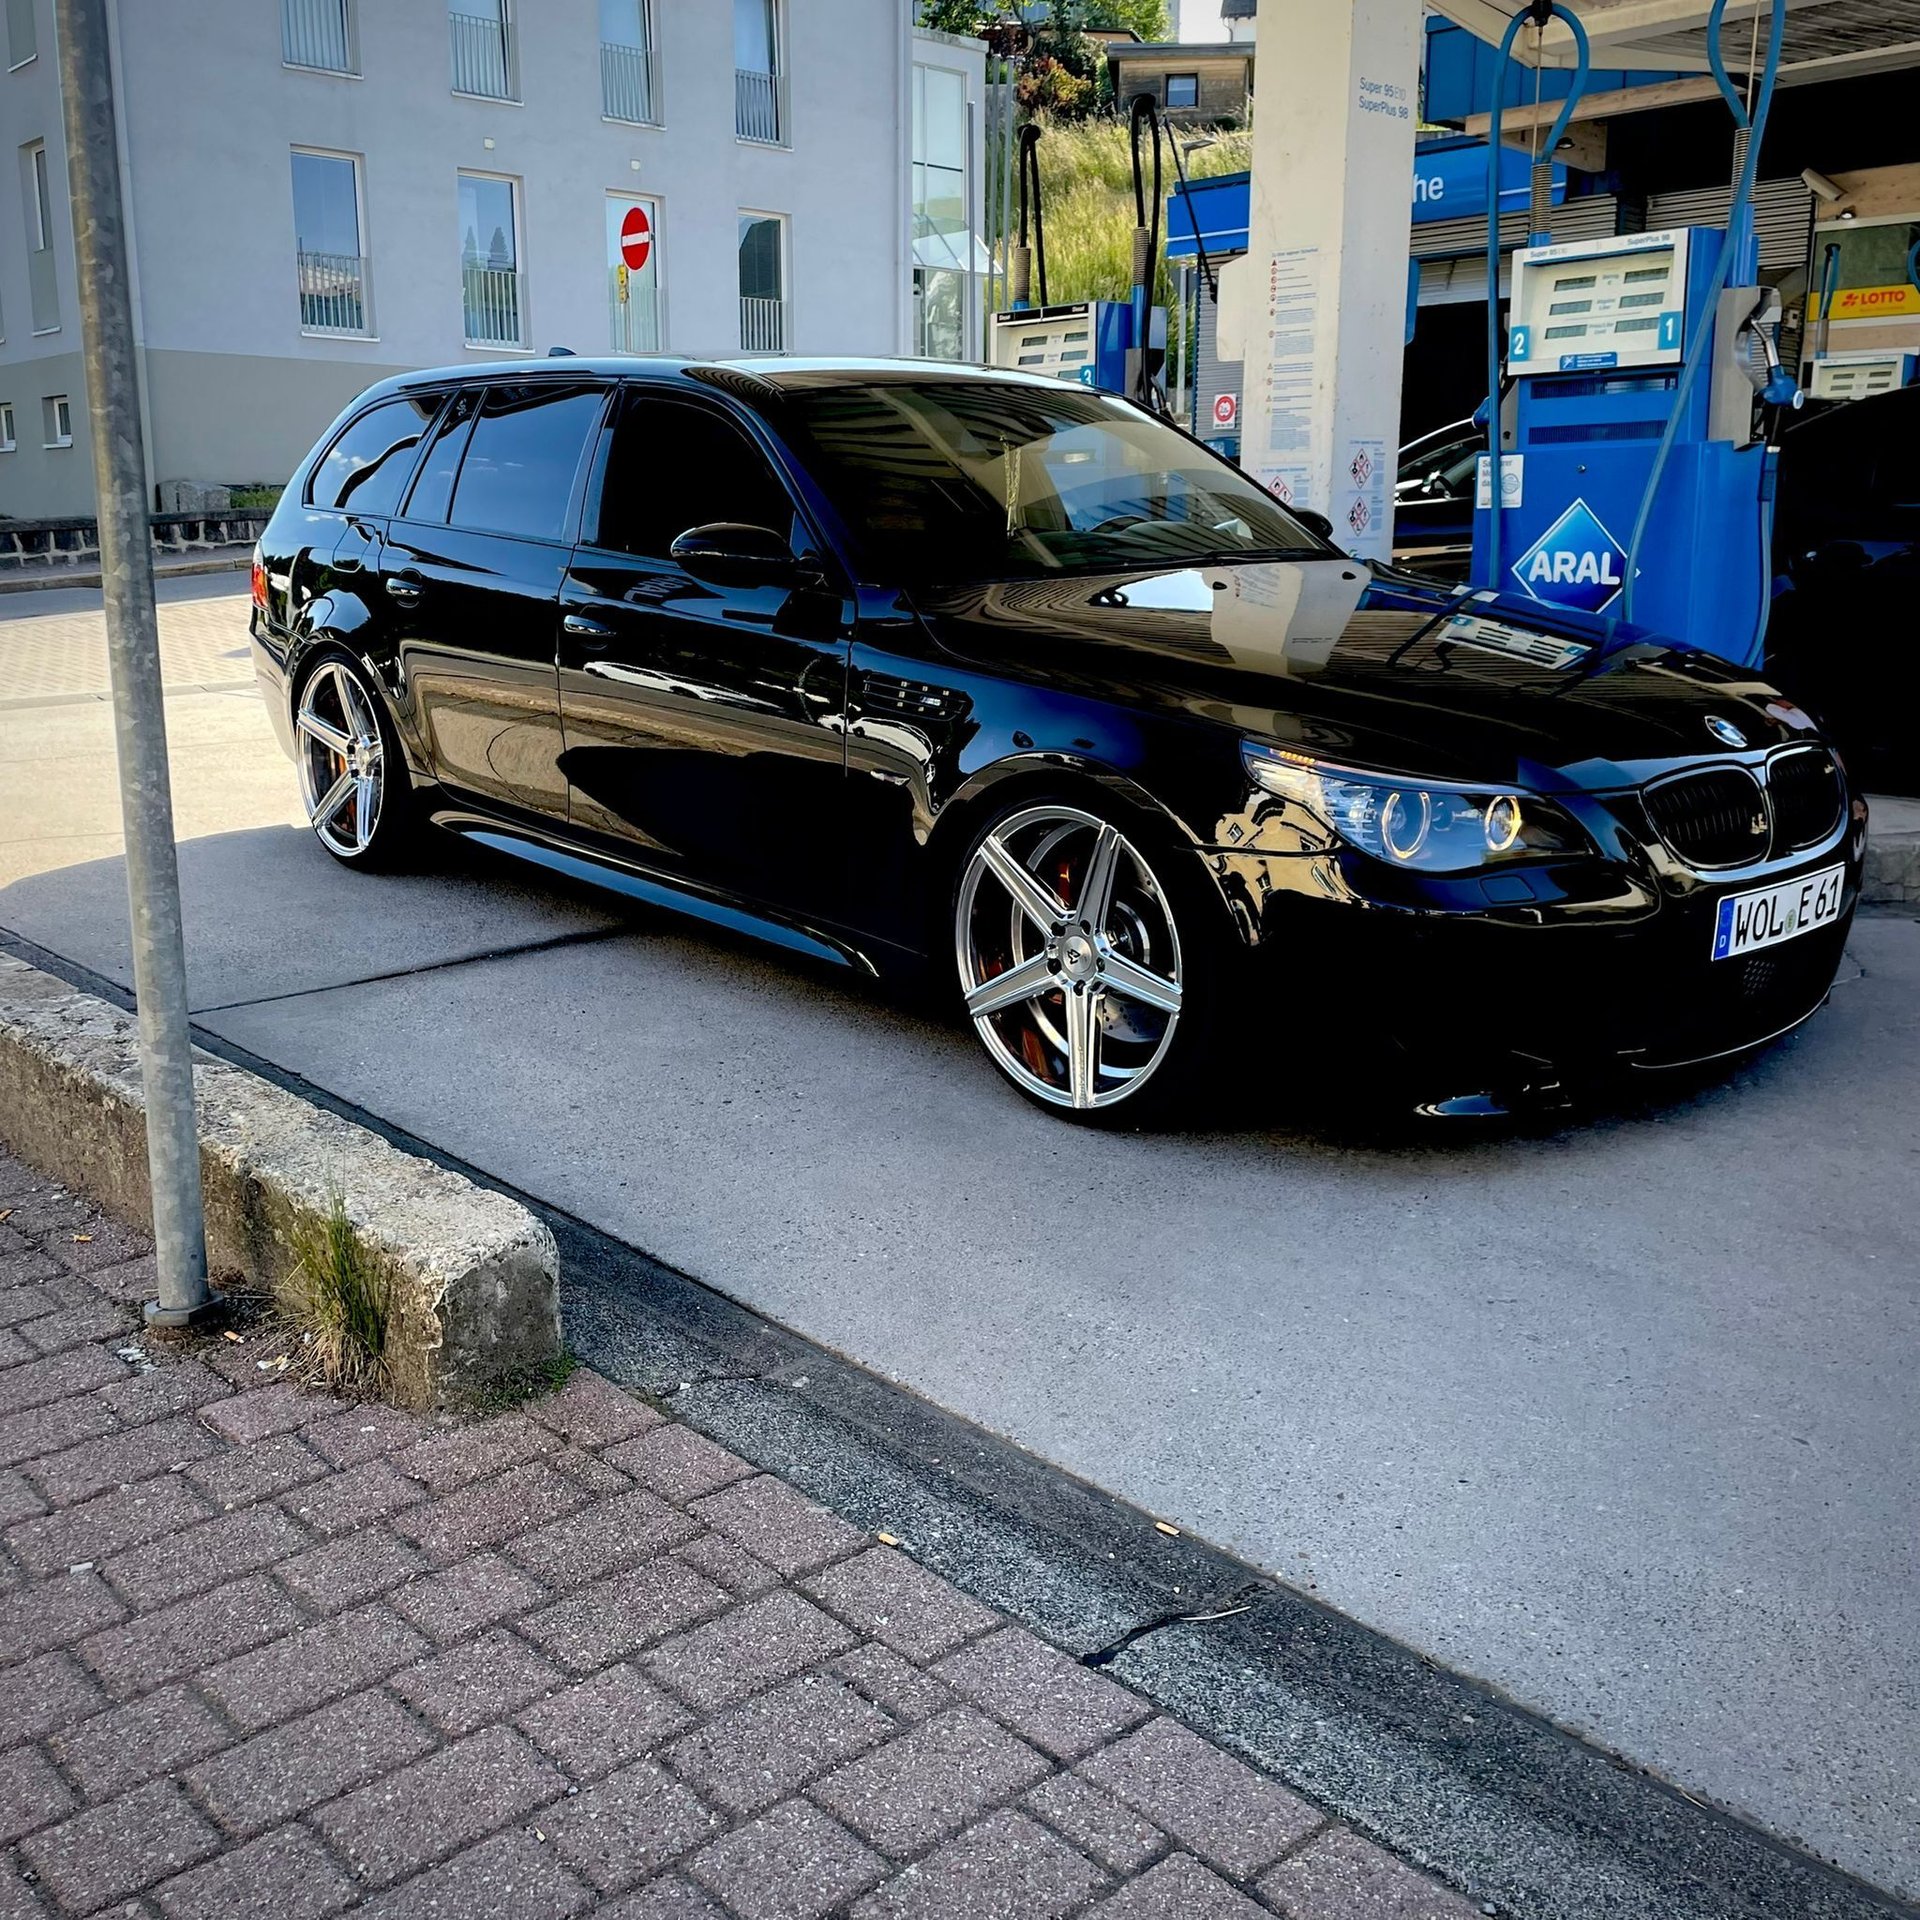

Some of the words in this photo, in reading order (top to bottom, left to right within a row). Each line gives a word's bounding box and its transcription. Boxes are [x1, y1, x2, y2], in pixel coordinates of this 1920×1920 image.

[1360, 76, 1382, 95] Super
[1384, 83, 1394, 98] 95
[1359, 95, 1397, 117] SuperPlus
[1398, 106, 1409, 119] 98
[1860, 290, 1905, 305] LOTTO
[1665, 317, 1674, 341] 1
[1513, 332, 1524, 355] 2
[1084, 369, 1092, 386] 3
[1528, 551, 1620, 585] ARAL
[1735, 895, 1784, 947] WOL
[1719, 935, 1727, 948] D
